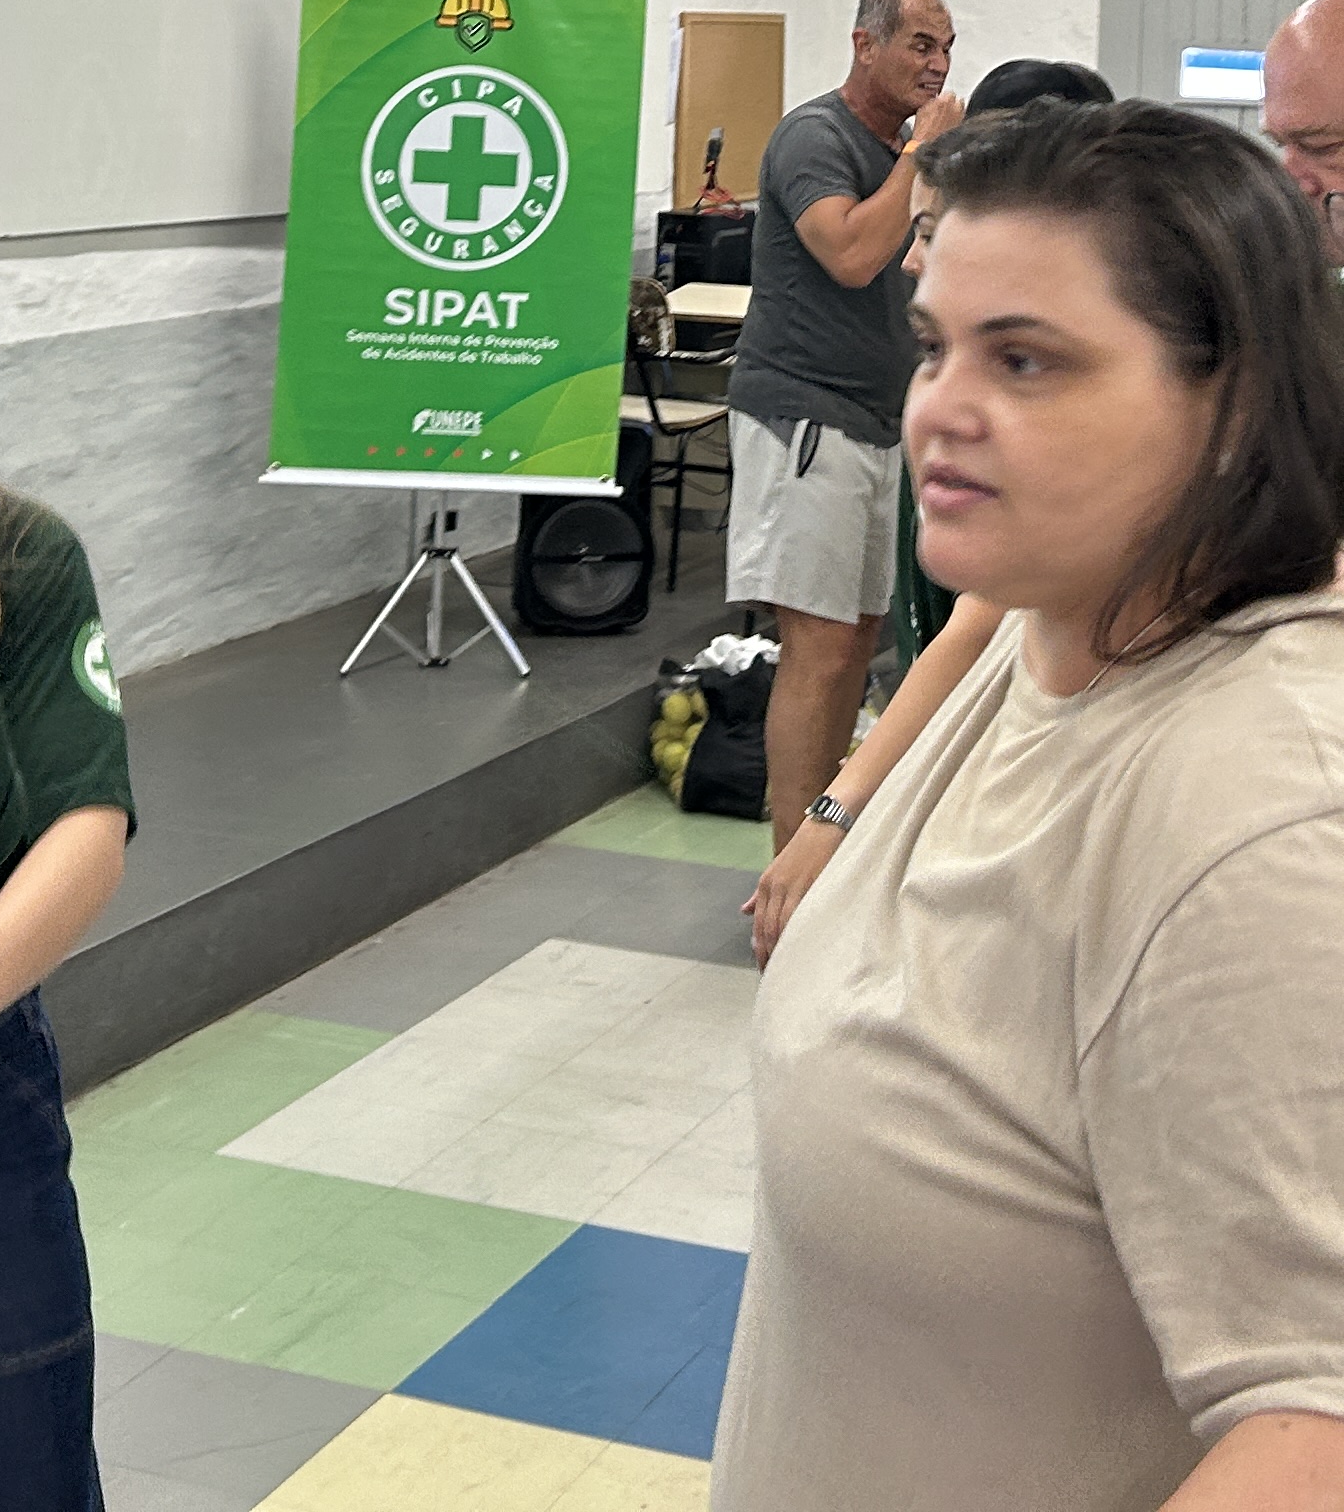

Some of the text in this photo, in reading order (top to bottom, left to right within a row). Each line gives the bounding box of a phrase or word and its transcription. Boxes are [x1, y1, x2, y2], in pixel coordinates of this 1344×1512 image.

[417, 78, 524, 118] CIPA
[374, 168, 555, 259] SEGURANÇA
[383, 287, 530, 329] SIPAT
[346, 328, 406, 345] Semana
[462, 334, 482, 348] de
[361, 346, 543, 366] de Acidentes de Trabalho
